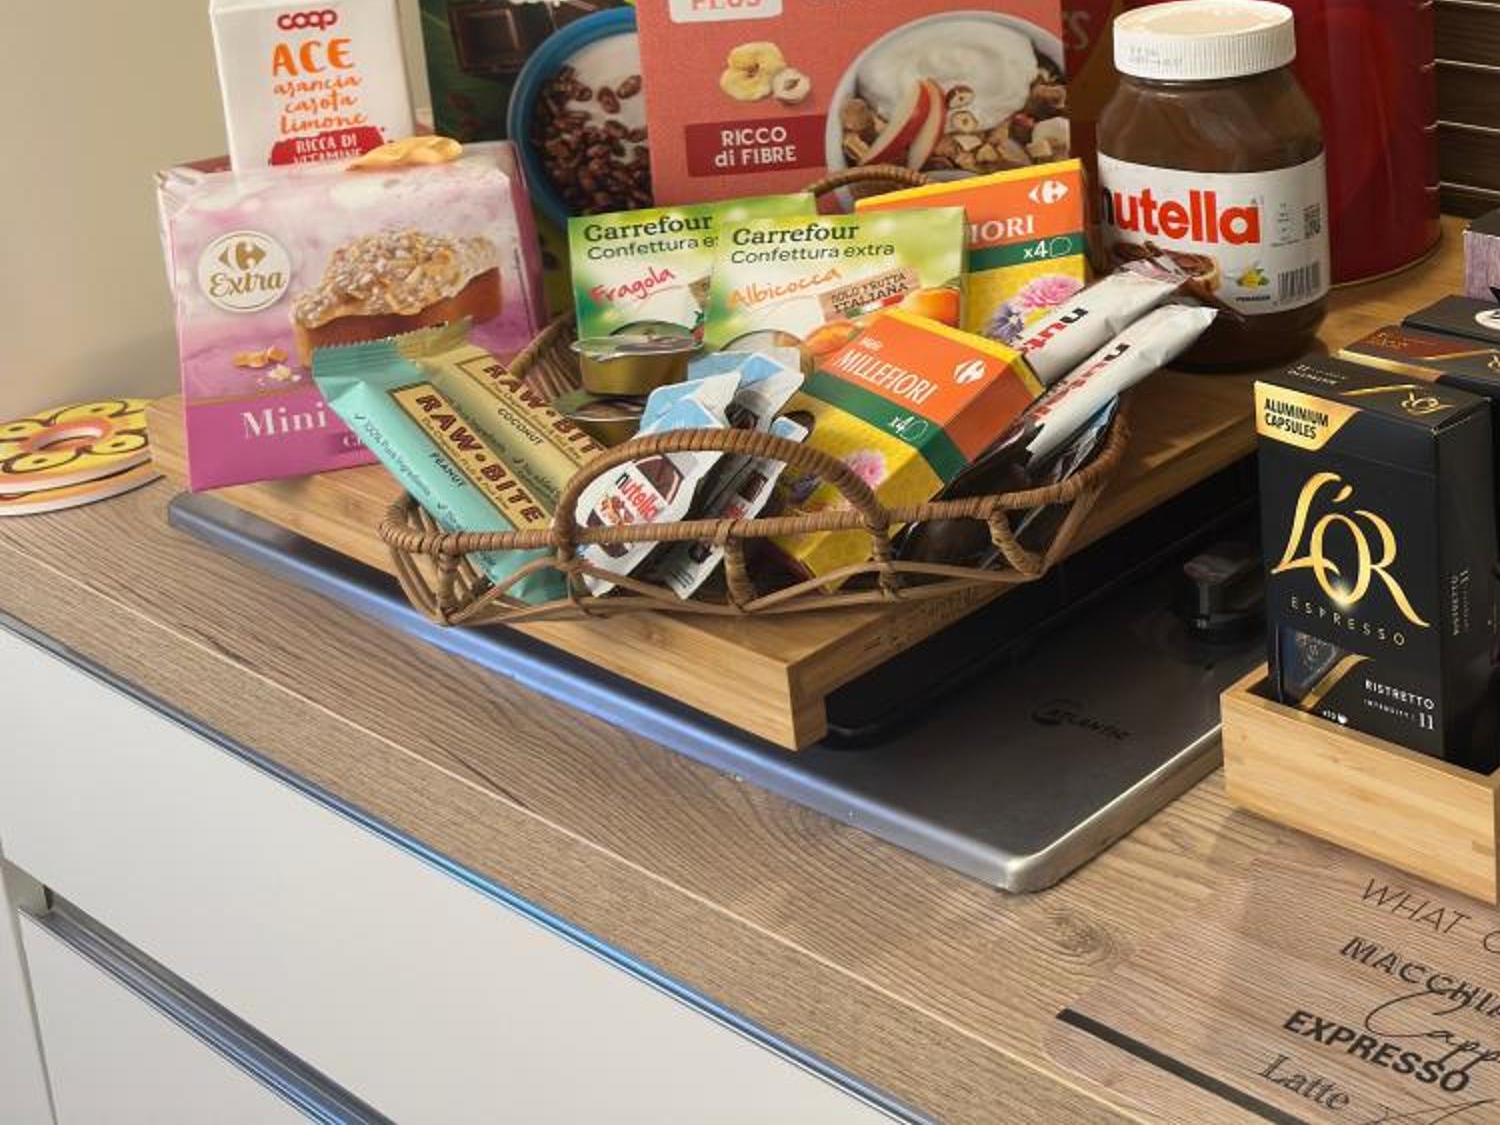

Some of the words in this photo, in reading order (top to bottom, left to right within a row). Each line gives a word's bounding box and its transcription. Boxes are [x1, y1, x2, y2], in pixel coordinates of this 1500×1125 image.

[277, 8, 338, 31] coop
[272, 38, 356, 77] ACE
[273, 75, 363, 96] arancia
[284, 89, 358, 114] carota
[280, 113, 369, 135] limone
[719, 126, 788, 147] RICCO
[715, 151, 735, 168] di
[742, 144, 797, 166] FIBRE
[584, 215, 713, 242] Carrefour
[970, 214, 1036, 243] IORI
[1101, 188, 1261, 245] nutella
[587, 237, 699, 261] Confettura
[732, 222, 860, 248] Carrefour
[1023, 240, 1048, 260] x4
[731, 245, 841, 266] Confettura
[844, 241, 896, 258] extra
[209, 269, 287, 299] Extra
[589, 266, 677, 301] Fragola
[728, 266, 843, 309] Albicocca
[833, 346, 939, 406] MILLEFIORI
[242, 401, 330, 440] Mini
[497, 406, 545, 446] COCONUT
[1264, 397, 1330, 428] ALUMINIUM
[1264, 411, 1318, 441] CAPSULES
[551, 412, 603, 454] BIT
[1290, 595, 1405, 646] ESPRESSO
[1364, 678, 1435, 710] RISTRETTO
[1360, 878, 1472, 935] WHAT
[1283, 1009, 1470, 1094] EXPRESSO
[1258, 1053, 1350, 1111] Latte
